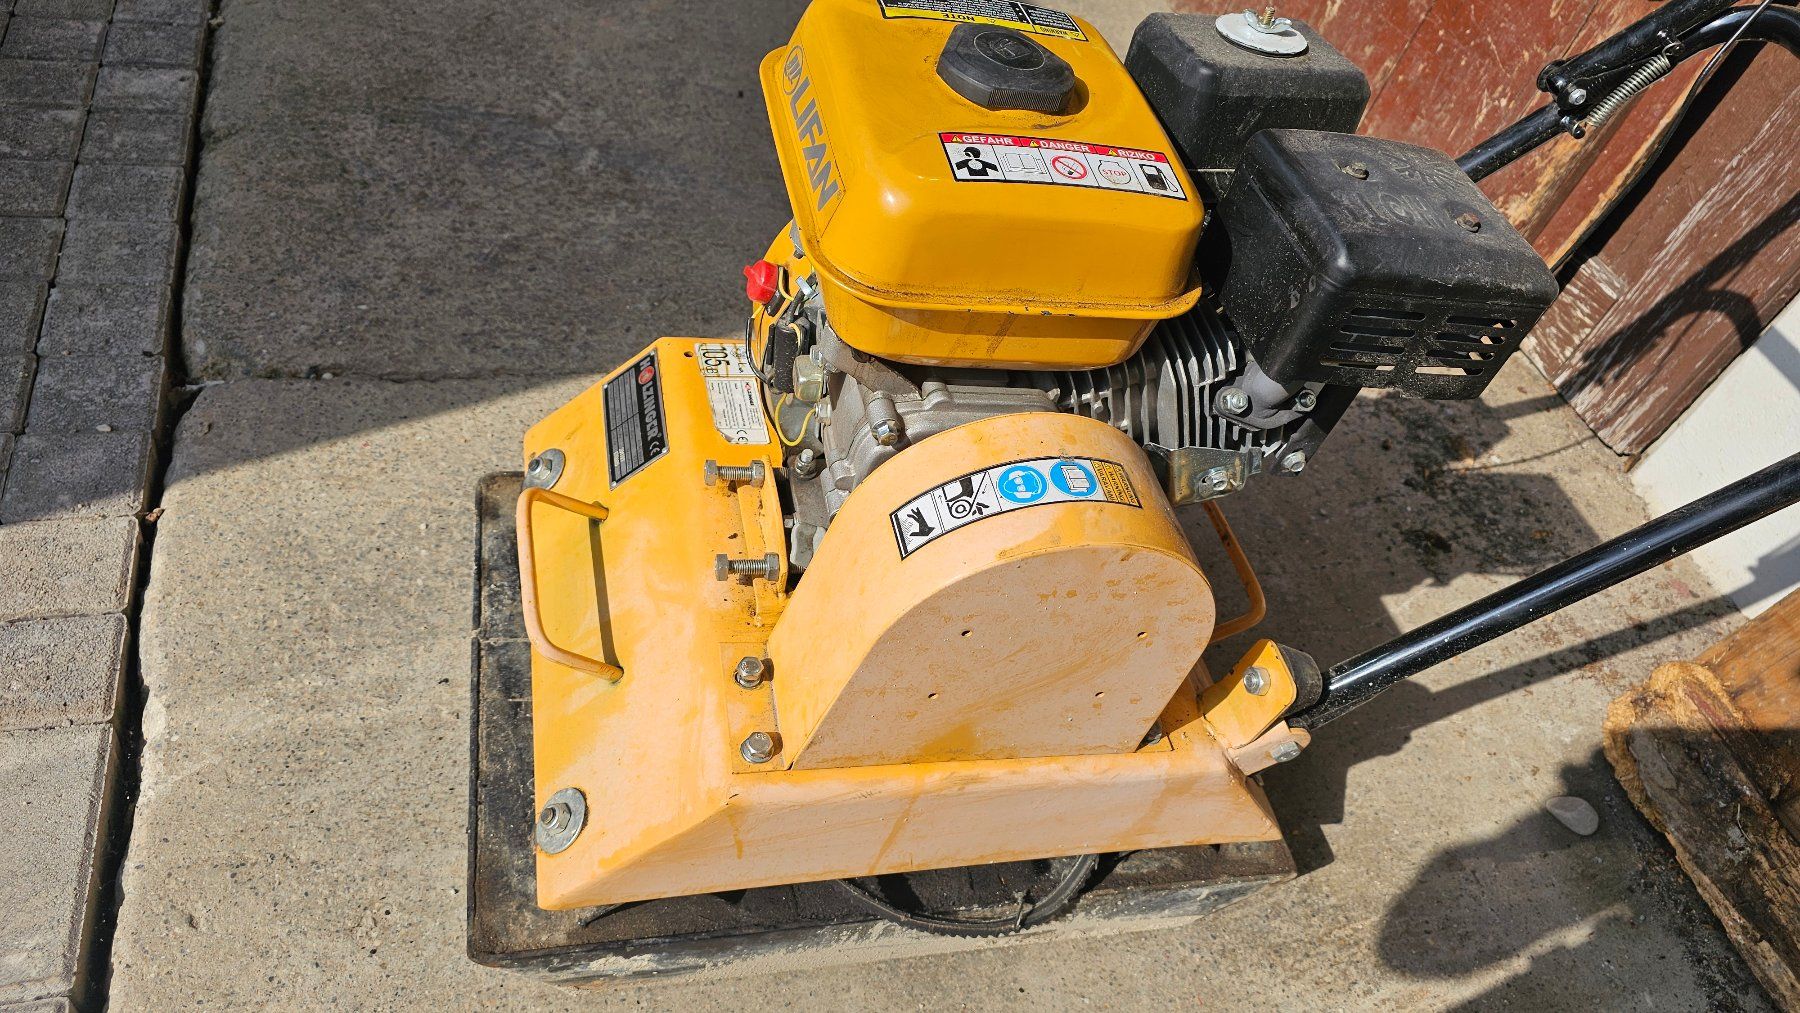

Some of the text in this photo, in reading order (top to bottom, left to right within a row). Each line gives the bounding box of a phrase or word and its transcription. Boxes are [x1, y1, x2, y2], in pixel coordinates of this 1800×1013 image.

[790, 76, 839, 212] LIFAN
[962, 134, 1013, 146] GEFAHR
[1040, 140, 1091, 153] DANGER
[1117, 149, 1156, 161] RIZIKO
[1102, 168, 1127, 178] STOP
[701, 346, 730, 366] 105
[638, 357, 660, 441] HOLZINGER
